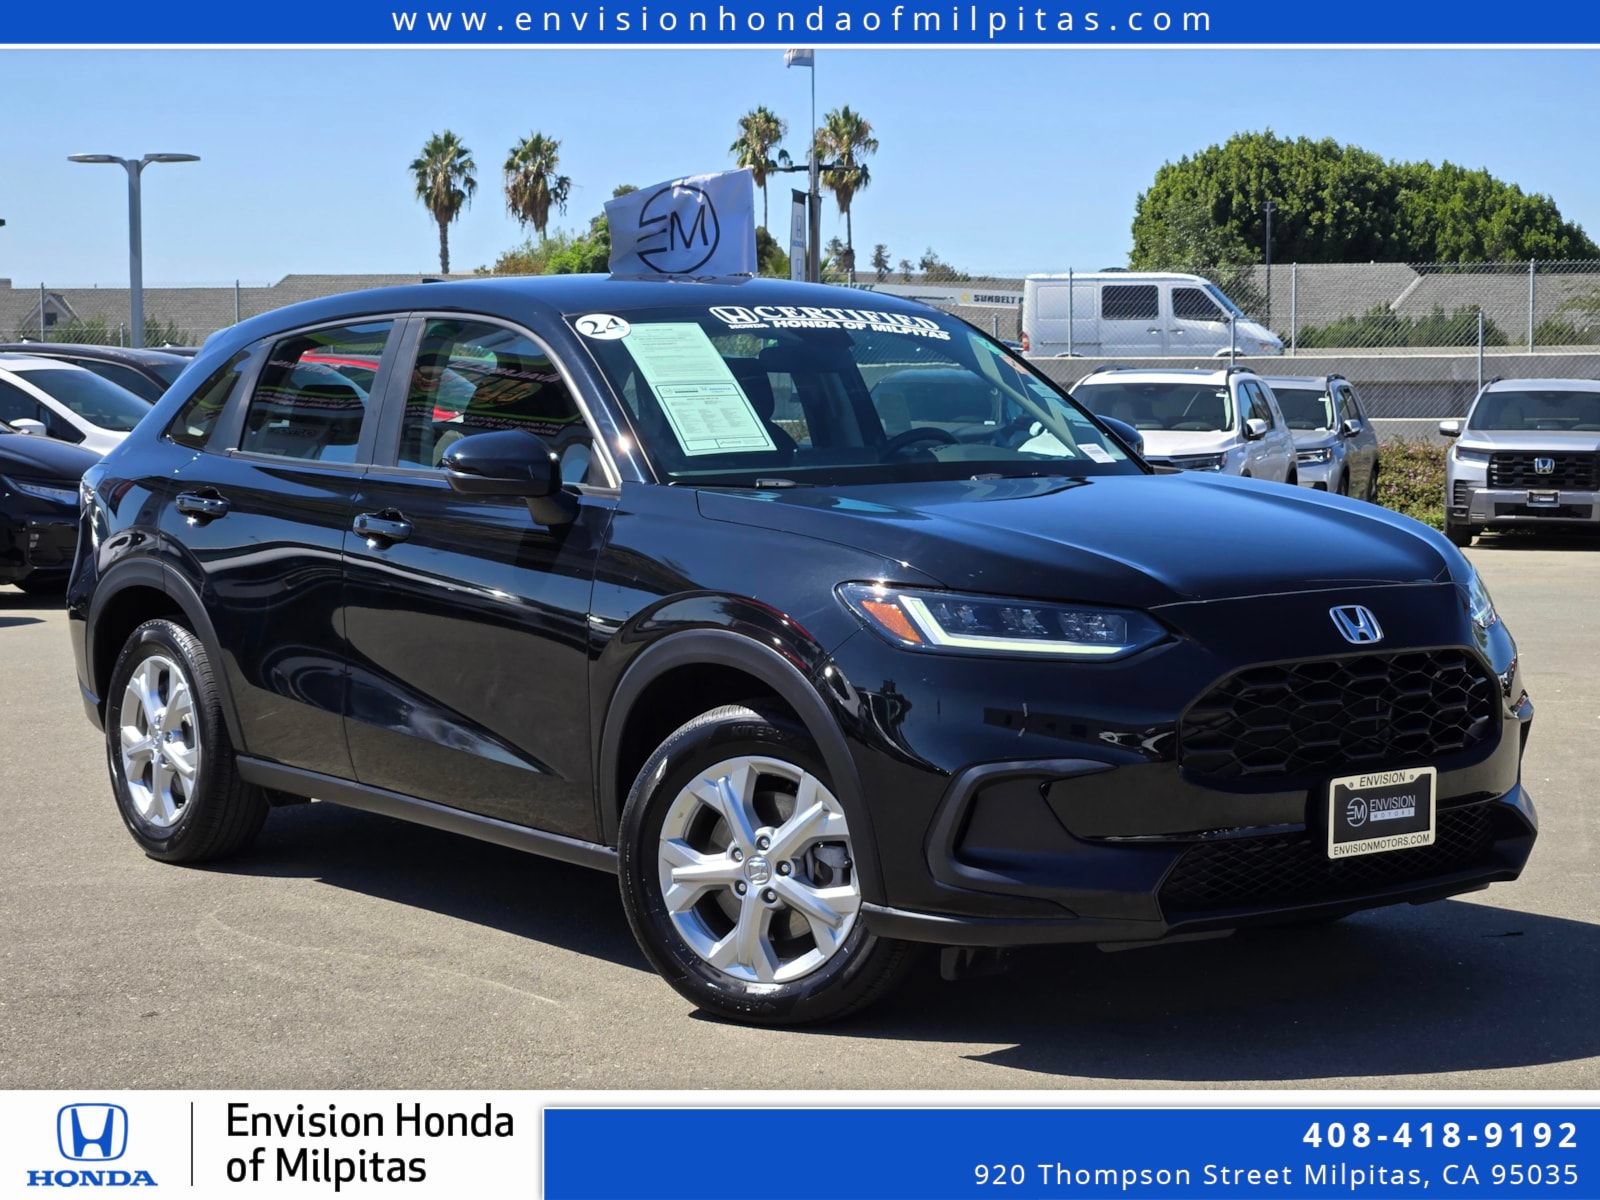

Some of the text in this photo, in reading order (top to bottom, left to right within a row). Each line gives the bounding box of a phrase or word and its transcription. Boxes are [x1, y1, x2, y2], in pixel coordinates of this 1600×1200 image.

[973, 293, 1016, 304] SUNBELT
[581, 317, 626, 335] 24
[753, 305, 940, 331] CERTIFIED
[774, 319, 951, 341] HONDA OF MILPITAS
[1359, 772, 1406, 788] ENVISION
[1369, 794, 1416, 812] ENVISION
[1373, 809, 1412, 819] MOTORS
[1333, 833, 1430, 857] ENVISIONMOTORS.COM
